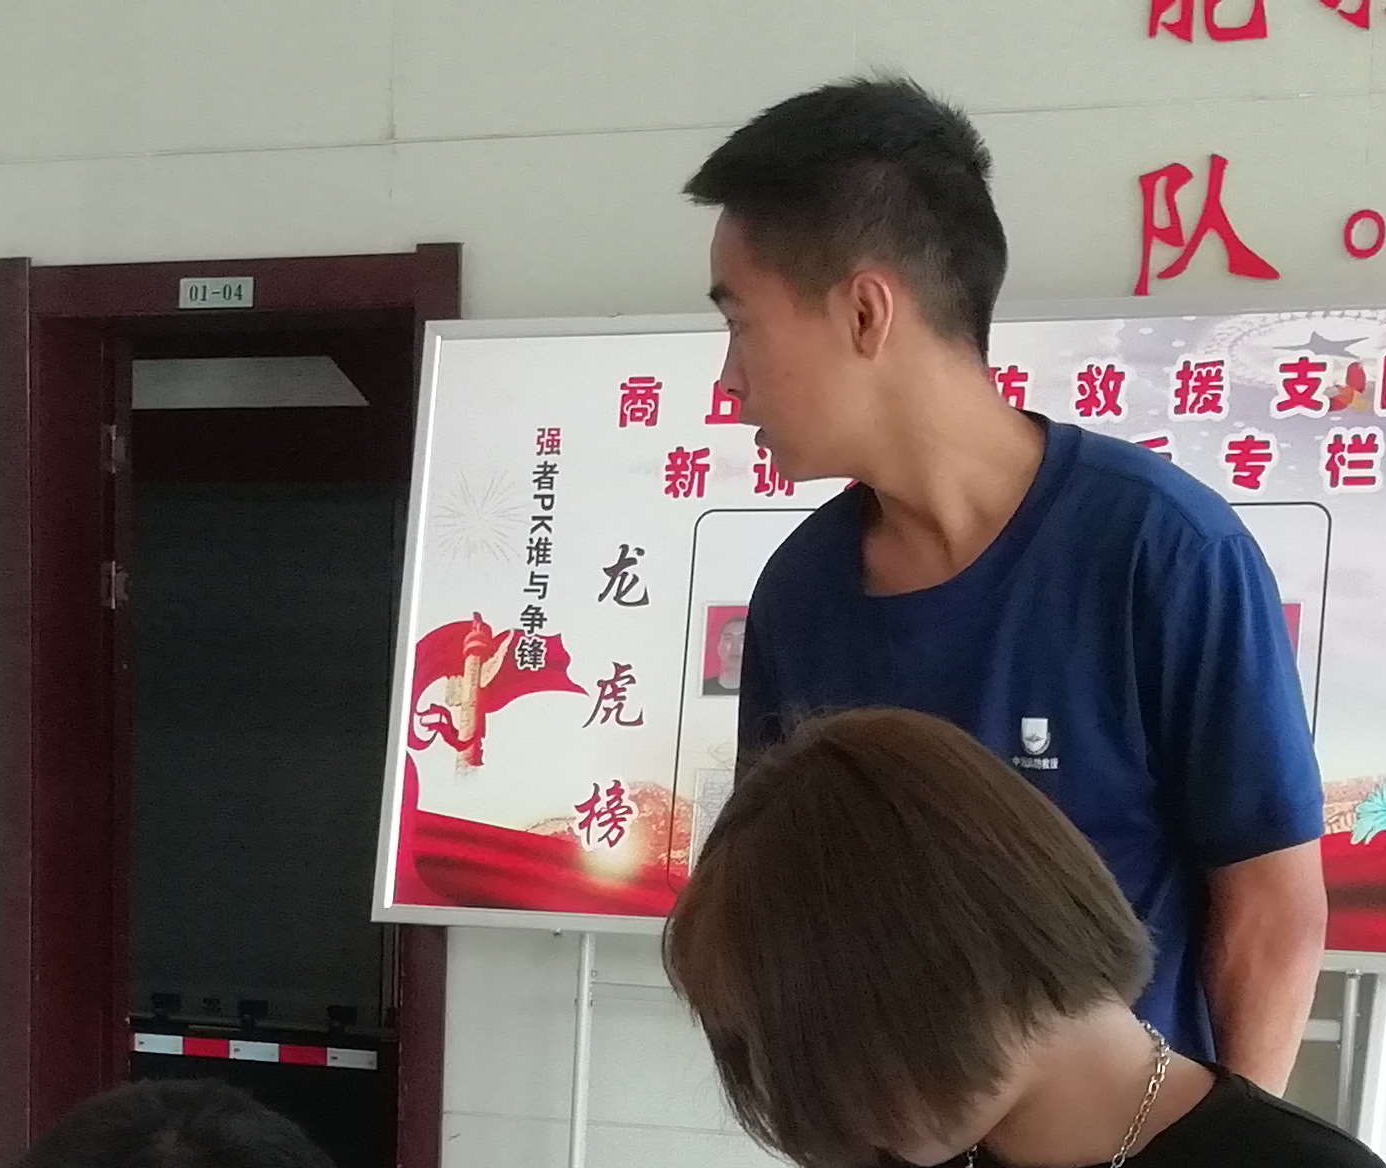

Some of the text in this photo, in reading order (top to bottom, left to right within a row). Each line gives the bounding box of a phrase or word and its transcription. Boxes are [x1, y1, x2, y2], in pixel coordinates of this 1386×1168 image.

[189, 284, 243, 302] 01-04
[516, 427, 562, 671] 强者PK谁与争锋
[574, 544, 649, 848] 龙虎榜
